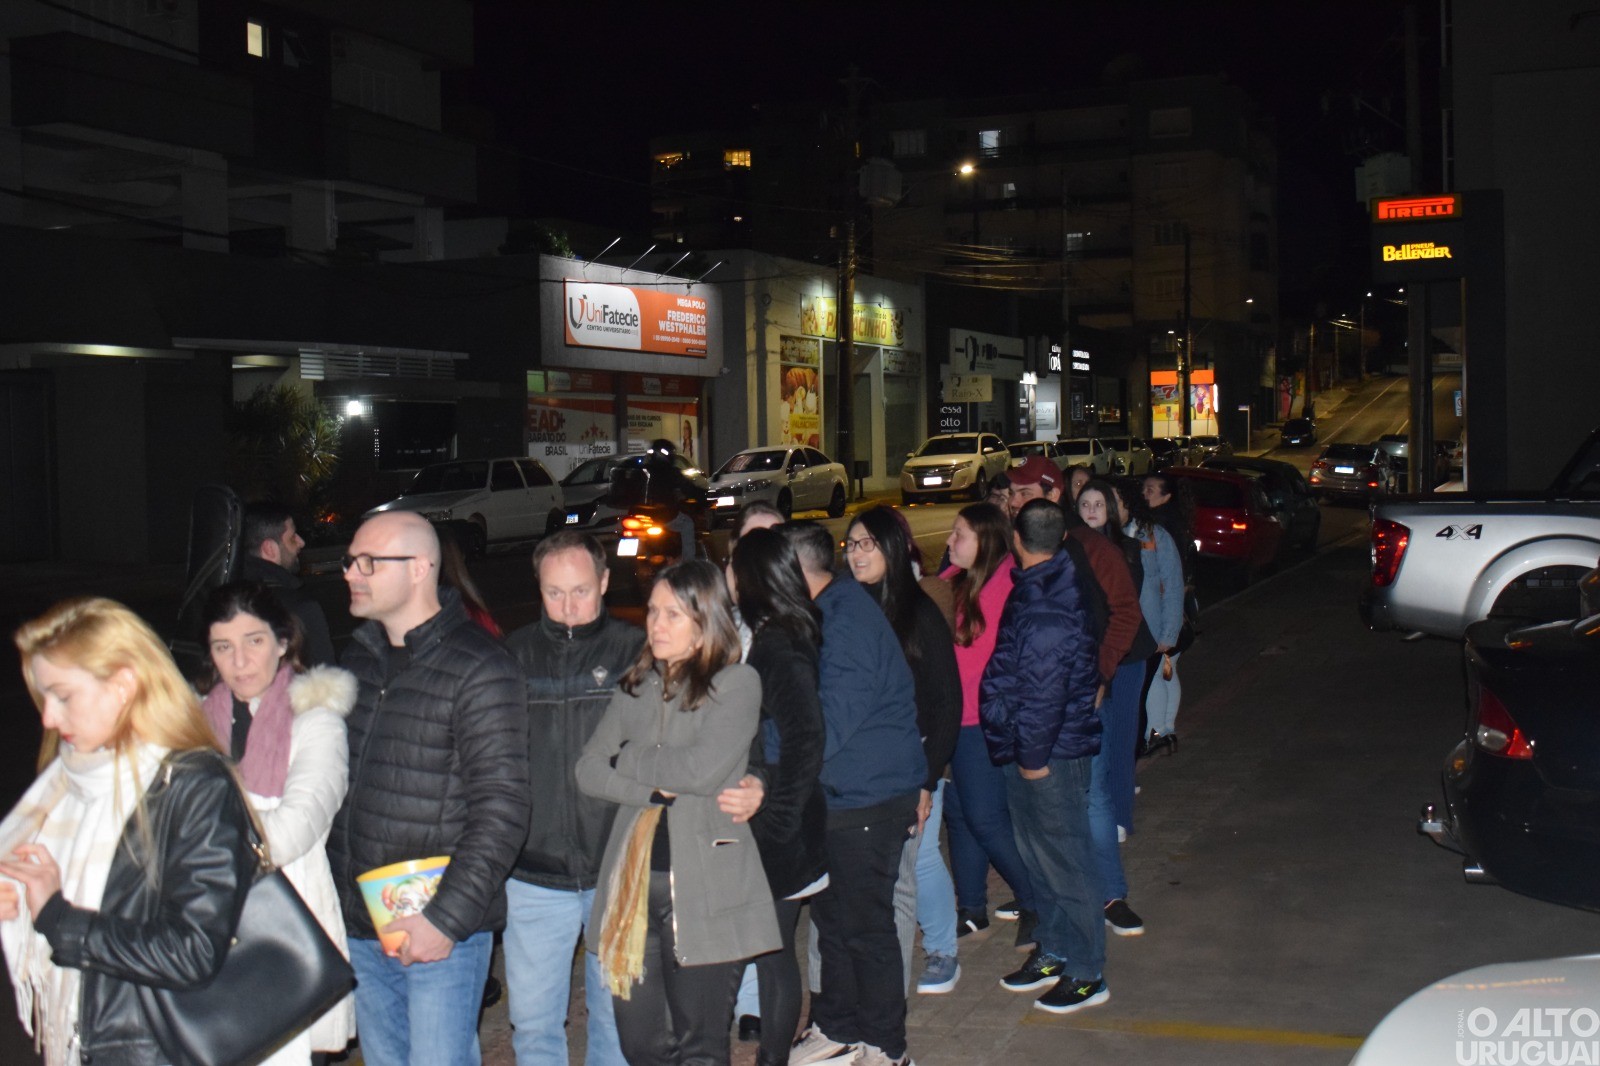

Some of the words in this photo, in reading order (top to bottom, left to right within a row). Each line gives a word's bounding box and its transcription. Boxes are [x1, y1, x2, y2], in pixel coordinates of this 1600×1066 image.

[1378, 197, 1455, 220] PIRELLI
[692, 300, 706, 310] POLO
[586, 304, 639, 328] UniFatecie
[667, 310, 706, 325] FREDERICO
[587, 324, 603, 332] CENTRO
[658, 320, 707, 337] WESTPHALEN
[940, 406, 962, 414] essa
[556, 433, 566, 443] DO
[545, 446, 568, 456] BRASIL
